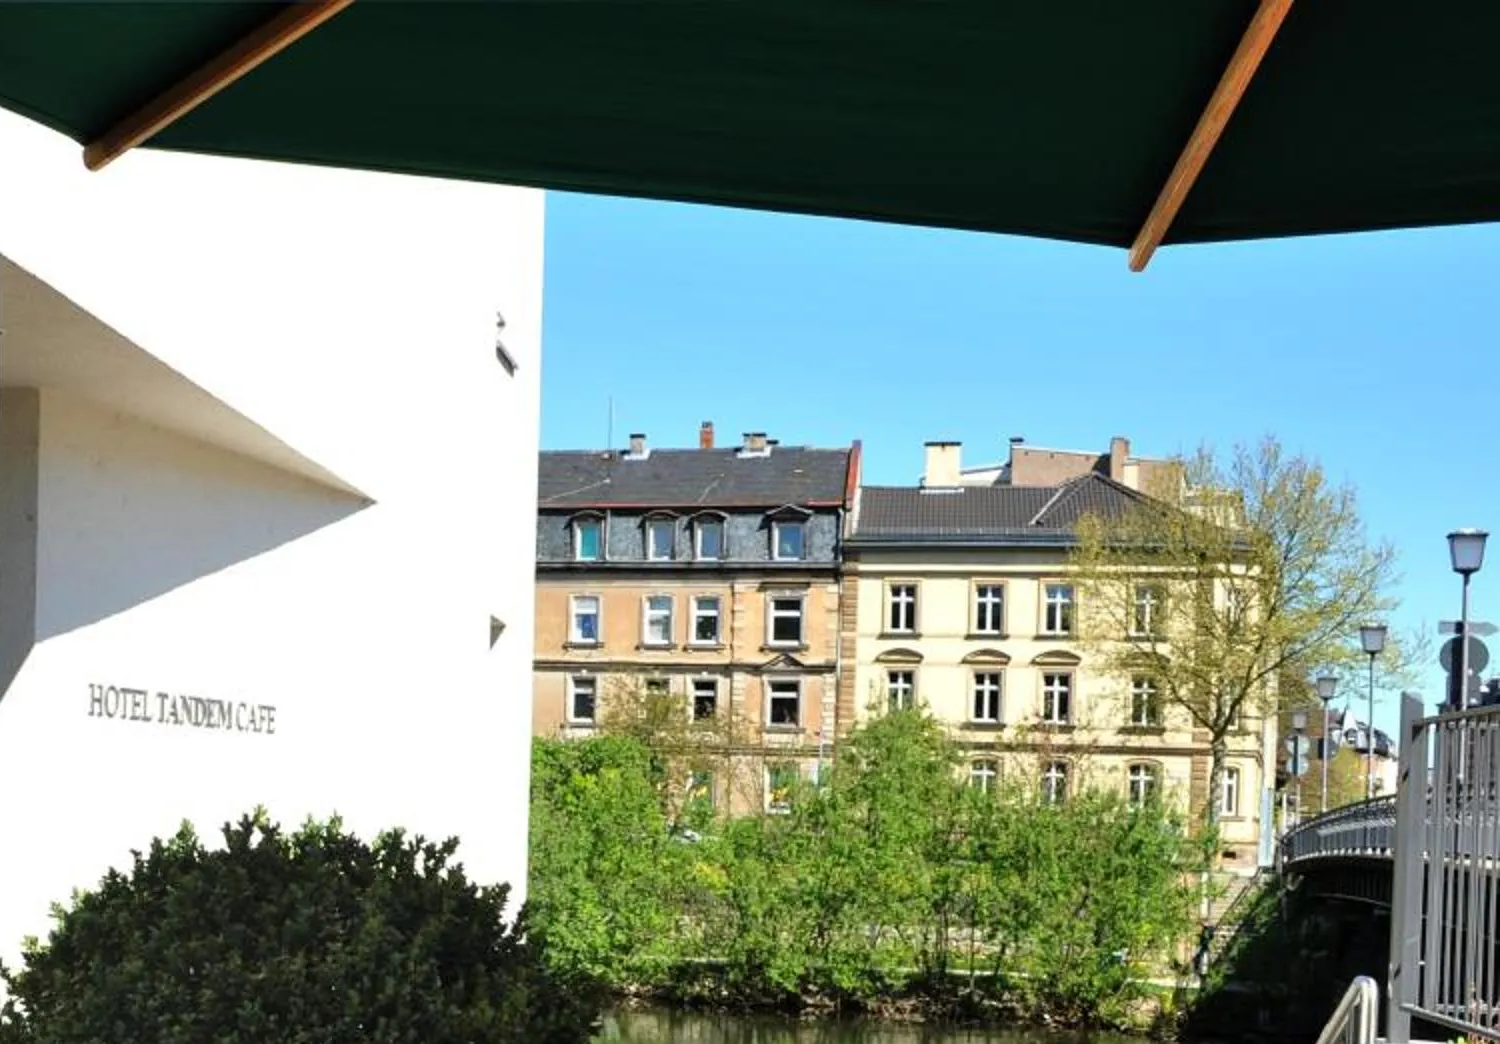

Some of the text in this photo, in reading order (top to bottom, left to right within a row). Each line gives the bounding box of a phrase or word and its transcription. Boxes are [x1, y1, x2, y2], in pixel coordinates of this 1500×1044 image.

[88, 684, 277, 735] HOTEL TANDEM CAFE
